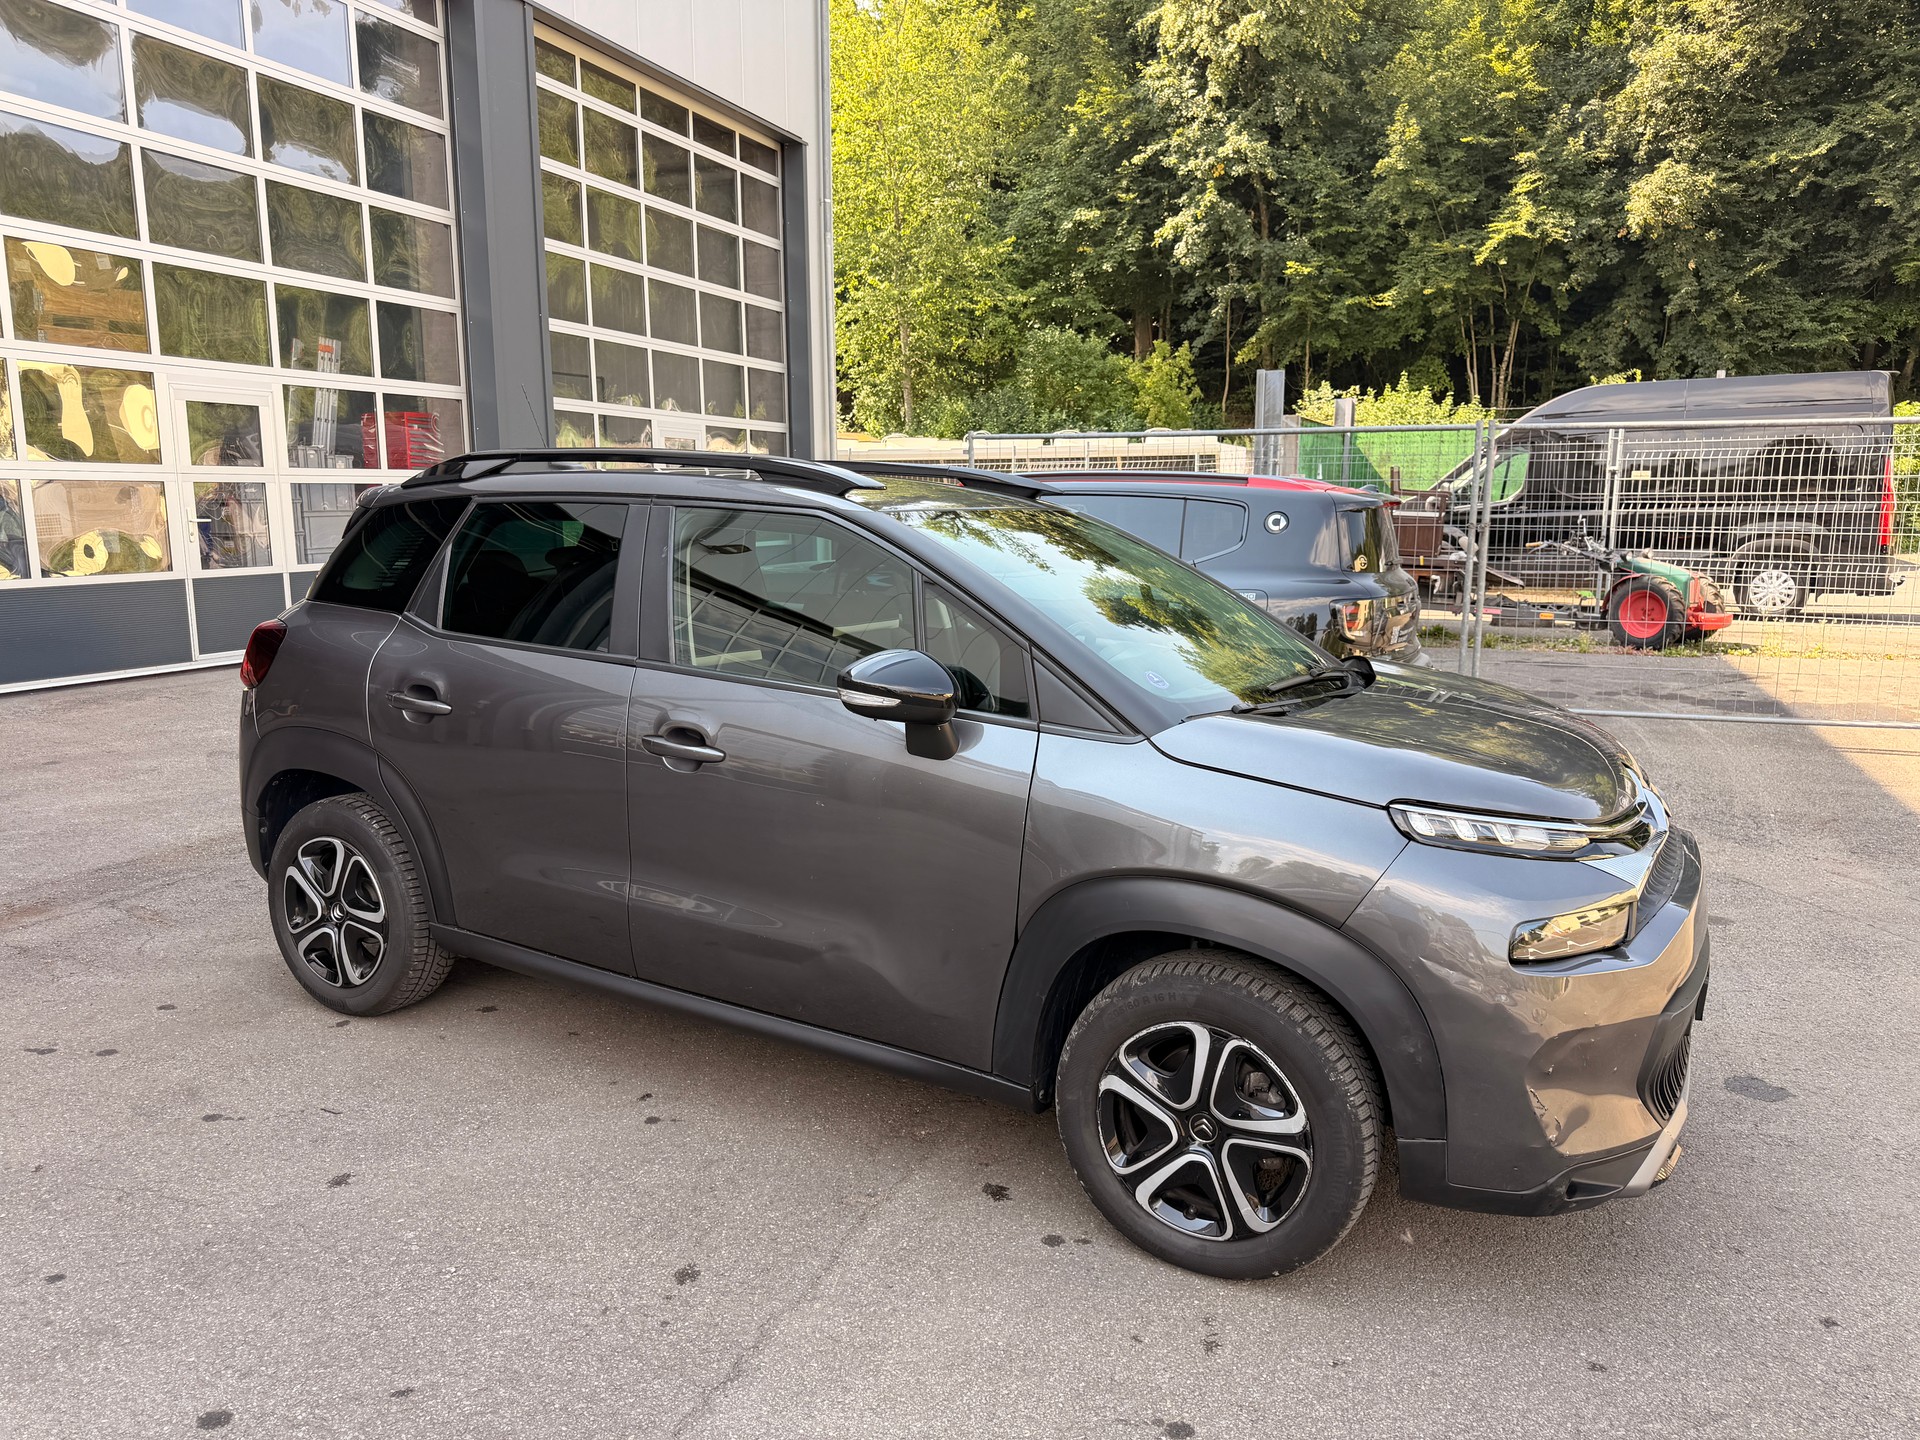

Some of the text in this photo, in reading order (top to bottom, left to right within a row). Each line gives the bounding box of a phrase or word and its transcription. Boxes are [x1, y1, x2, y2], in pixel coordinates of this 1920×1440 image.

[1142, 996, 1150, 1005] R
[1154, 993, 1165, 1002] 16
[1167, 992, 1176, 1001] H
